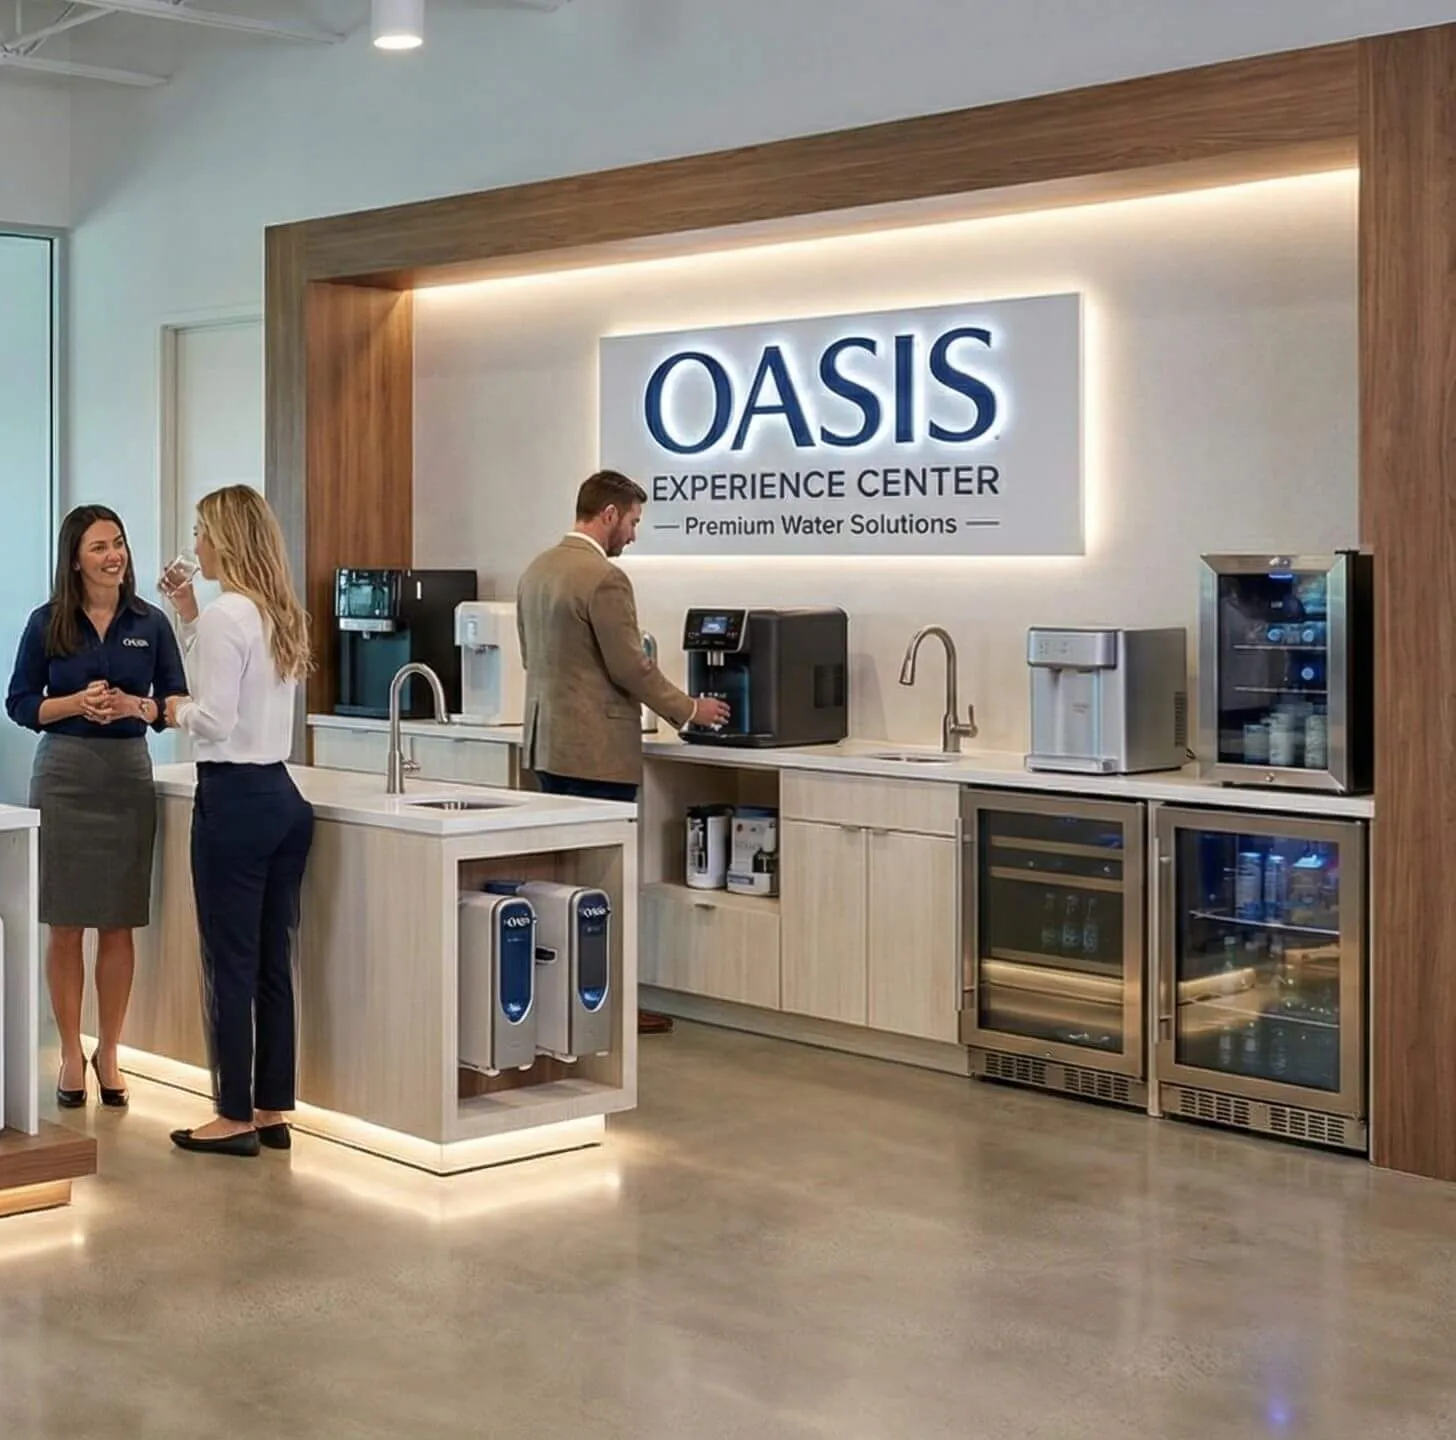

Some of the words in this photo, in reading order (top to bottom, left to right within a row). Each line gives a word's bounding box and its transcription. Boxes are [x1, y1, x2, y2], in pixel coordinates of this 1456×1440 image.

[644, 327, 998, 455] OASIS
[652, 470, 846, 502] EXPERIENCE
[857, 466, 999, 497] CENTER
[685, 516, 775, 536] Premium
[781, 514, 843, 535] Water
[850, 512, 957, 535] Solutions
